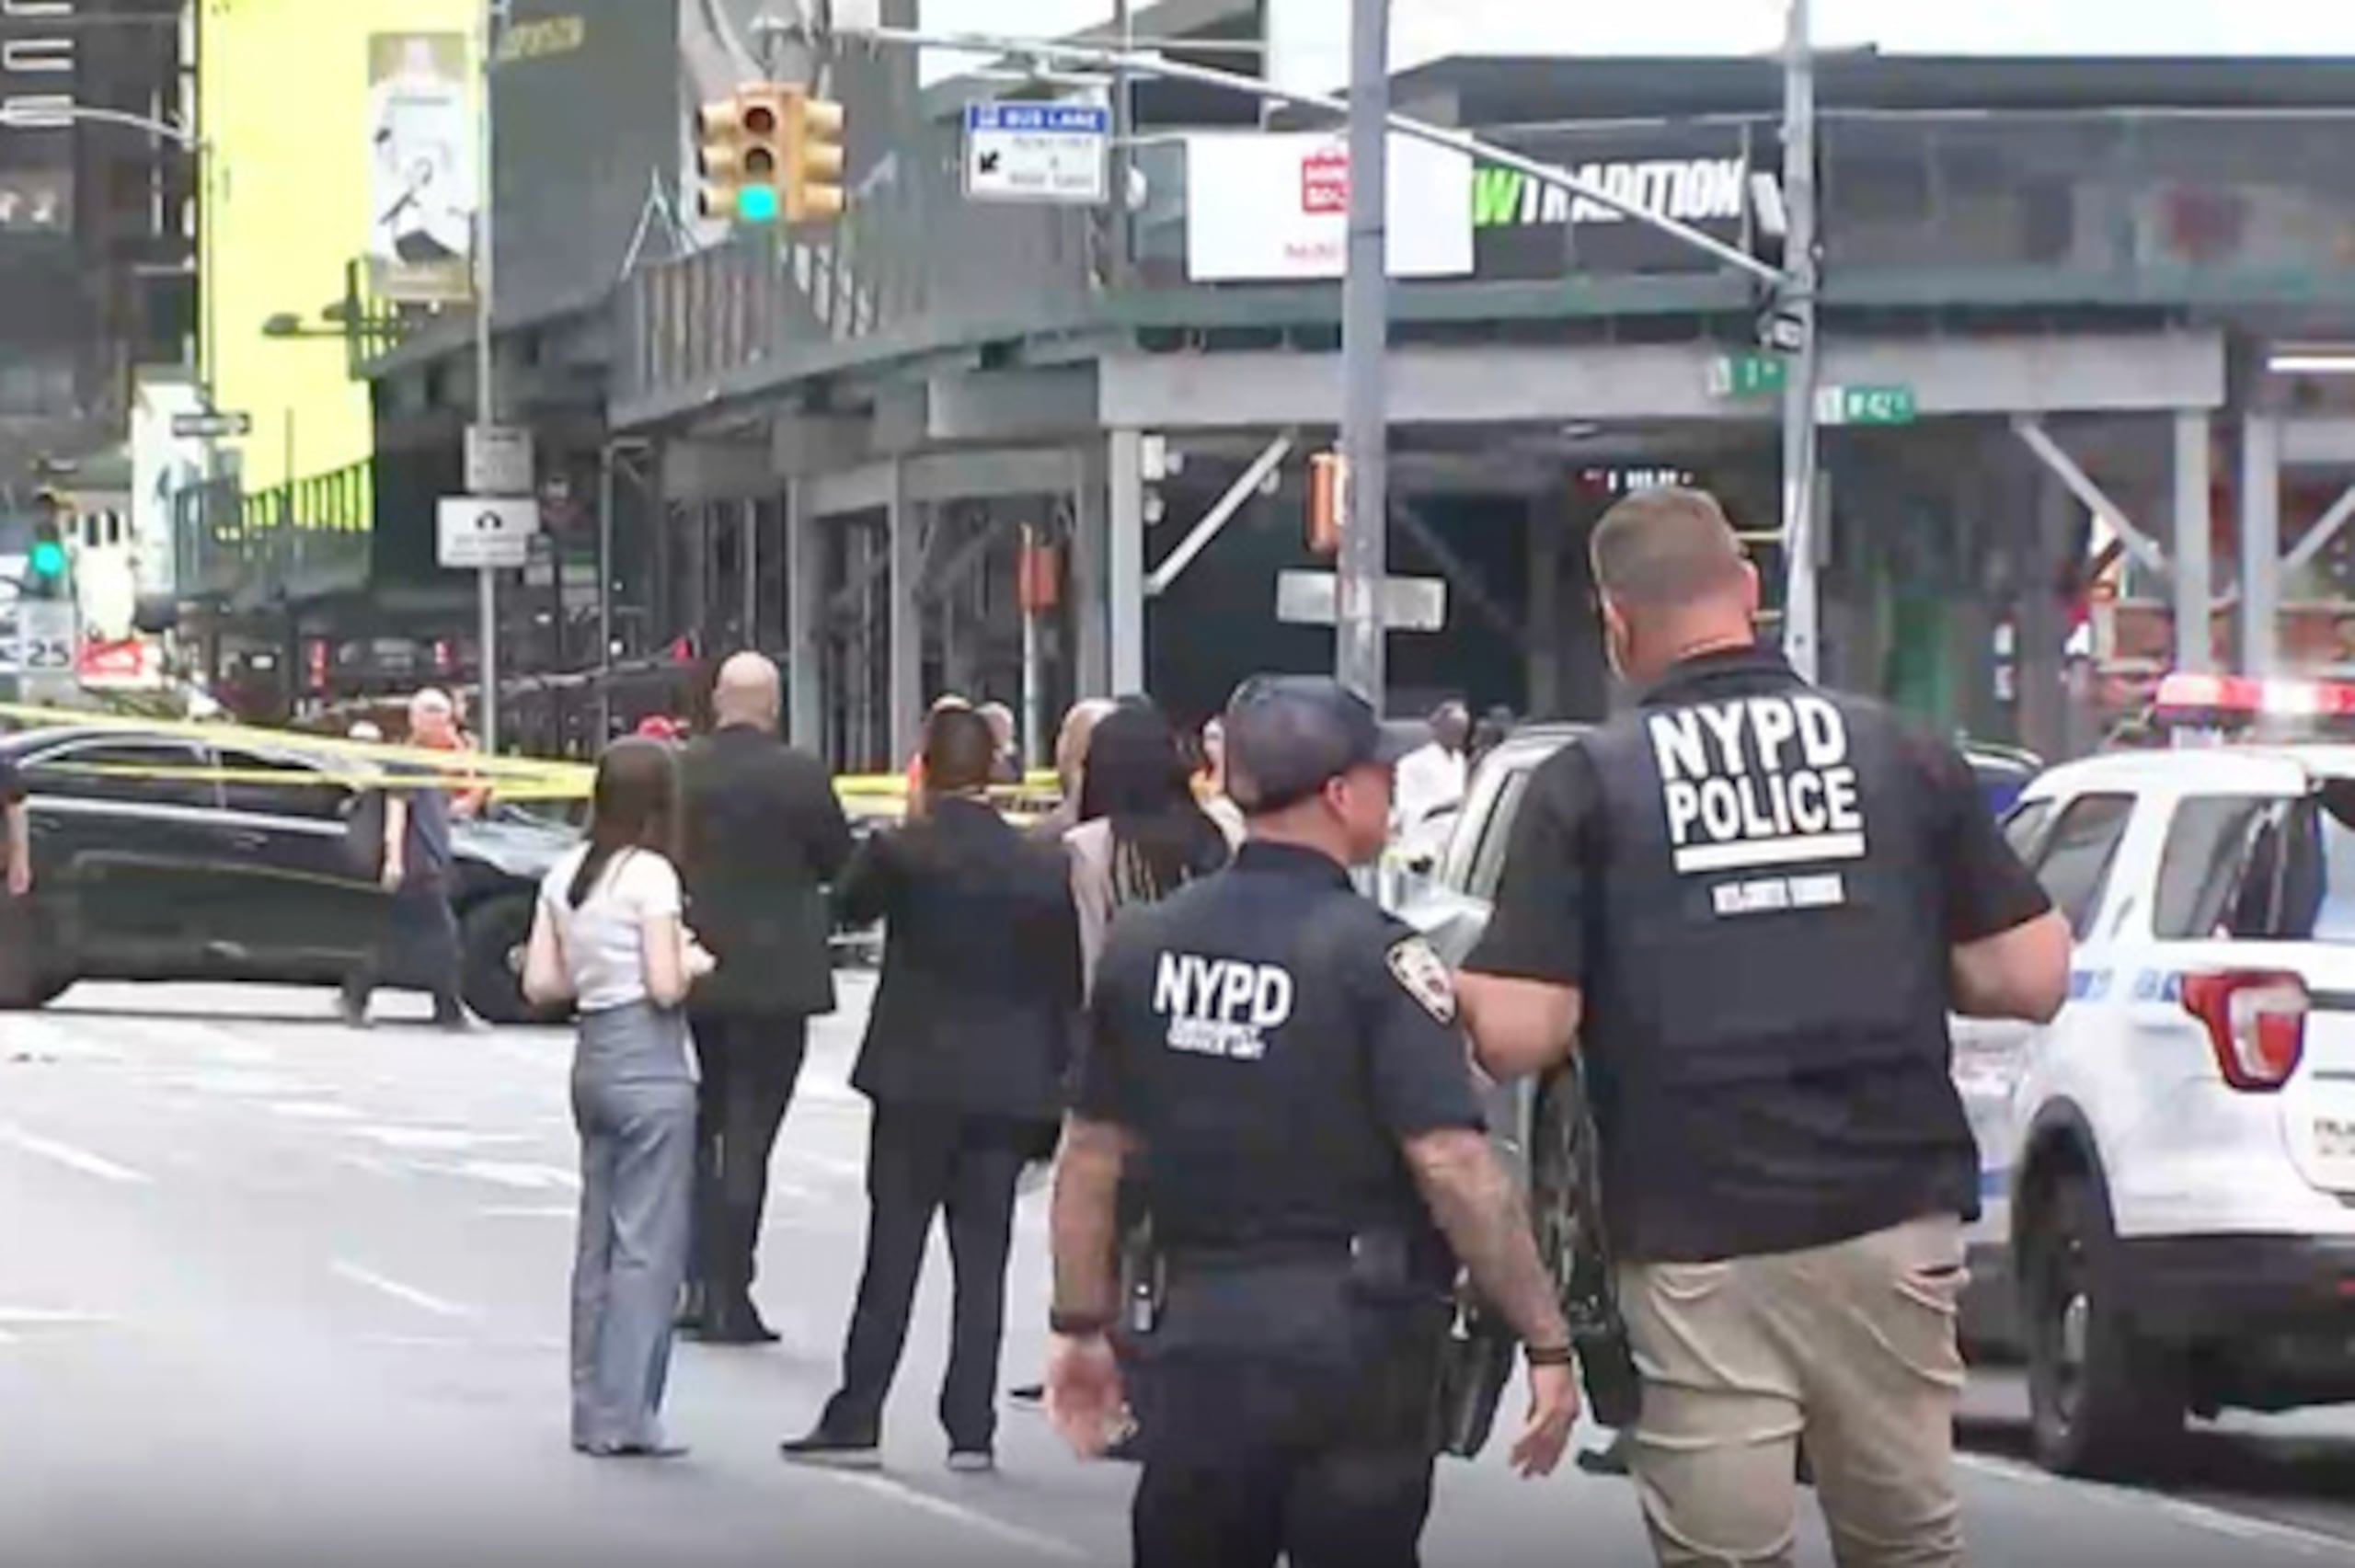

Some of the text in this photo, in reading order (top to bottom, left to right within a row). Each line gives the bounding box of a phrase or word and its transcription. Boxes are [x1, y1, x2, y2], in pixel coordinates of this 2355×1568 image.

[1005, 109, 1043, 128] BUS
[27, 641, 70, 668] 25
[1649, 696, 1846, 782] NYPD
[1663, 766, 1863, 844] POLICE
[1153, 948, 1292, 1027] NYPD
